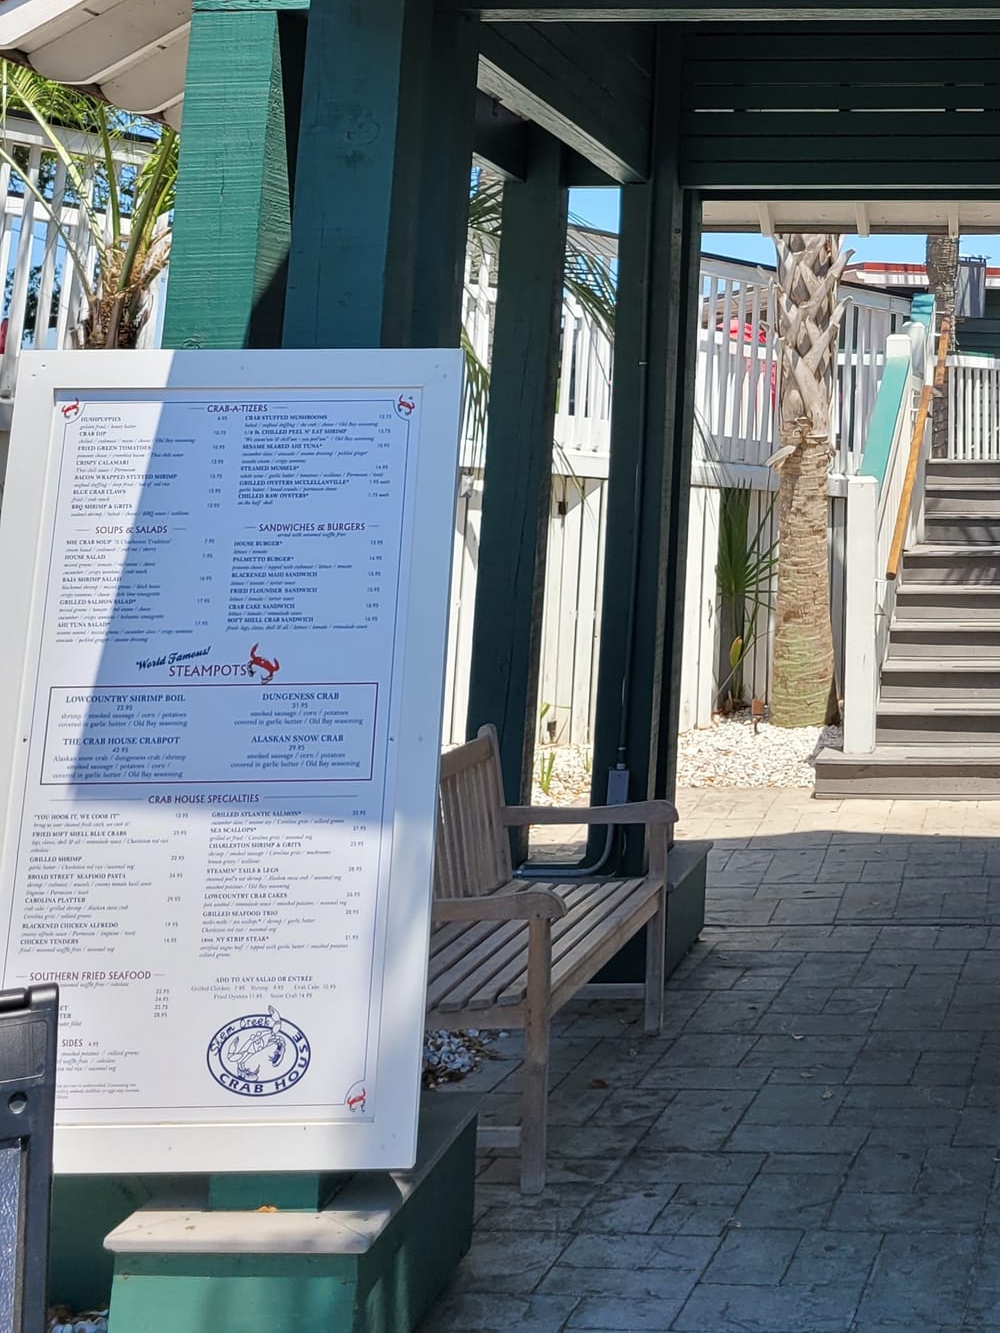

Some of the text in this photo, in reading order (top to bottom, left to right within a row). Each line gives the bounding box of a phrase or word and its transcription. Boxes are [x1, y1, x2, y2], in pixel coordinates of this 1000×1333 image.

[207, 404, 268, 413] CRAB-A-TIZERS
[95, 525, 168, 534] SOUPS & SALADS
[259, 523, 315, 532] SANDWICHES
[327, 522, 366, 531] BURGERS
[136, 645, 212, 671] World Famous!
[169, 664, 247, 677] STEAMPOTS
[65, 694, 186, 703] LOWCOUNTRY SHRIMP BOIL
[262, 692, 340, 701] DUNGENESS CRAB
[62, 737, 181, 745] THE CRAB HOUSE CRABPOT
[251, 734, 344, 743] ALASKAN SNOW CRAB
[148, 794, 260, 803] CRAB HOUSE SPECIALTIES
[29, 971, 151, 981] SOUTHERN FRIED SEAFOOD
[61, 1039, 83, 1048] SIDES
[219, 1031, 309, 1093] CRAB HOUSE
